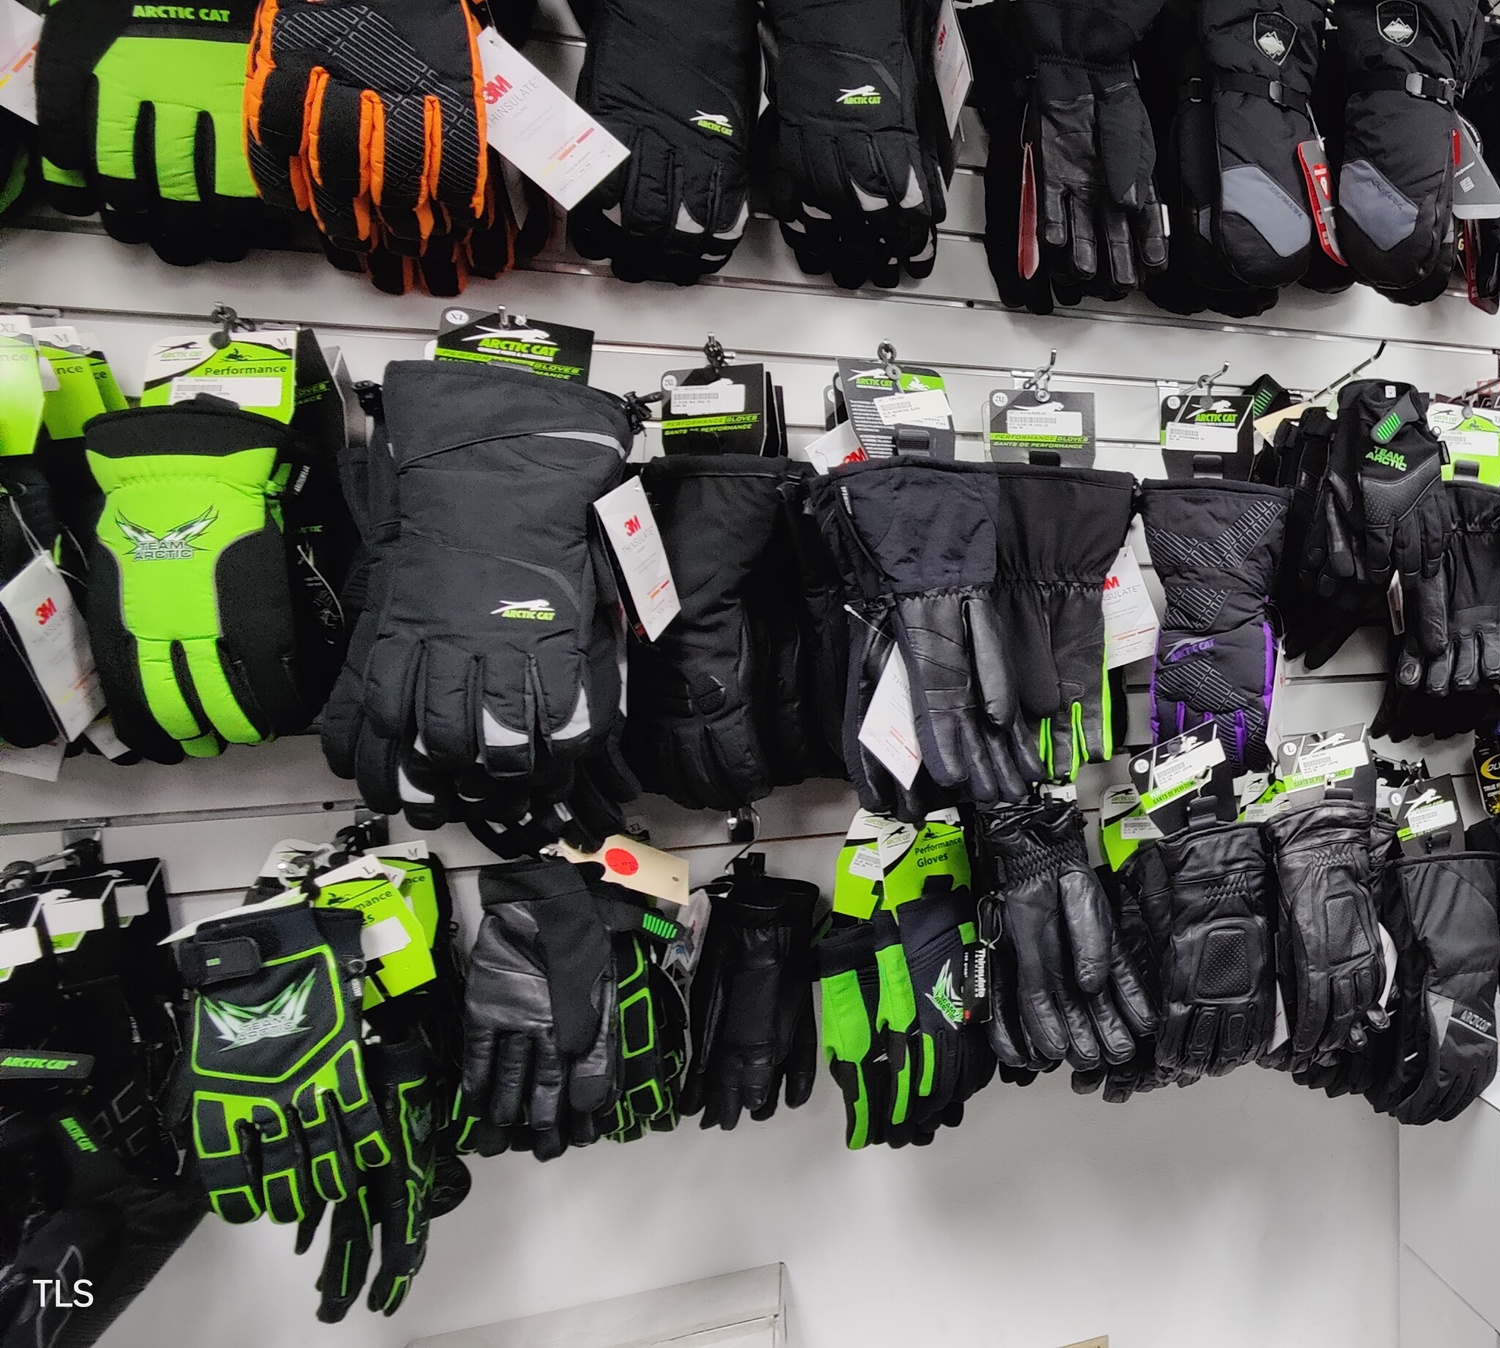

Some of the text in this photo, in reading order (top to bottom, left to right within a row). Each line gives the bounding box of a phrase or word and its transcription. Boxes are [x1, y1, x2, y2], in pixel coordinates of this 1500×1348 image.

[133, 5, 230, 23] ARCTIC CAT
[484, 74, 513, 105] 3M
[844, 94, 881, 105] ARCTIC CAT
[697, 119, 733, 136] ARCTIC CAT
[477, 338, 526, 353] ARCTIC
[528, 344, 560, 357] CAT
[204, 365, 287, 376] Performance
[856, 378, 893, 387] ARCTIC CAT
[1195, 413, 1236, 423] ARCTIC CAT
[1365, 453, 1407, 472] ARCTIC
[1373, 446, 1404, 463] TEAM
[623, 515, 641, 537] 3M
[138, 540, 186, 552] TEAM
[133, 548, 195, 562] ARCTIC
[1104, 576, 1120, 590] M
[35, 597, 58, 625] 3M
[502, 608, 555, 621] ARCTIC CAT
[1171, 638, 1215, 662] ARCTIC CAT
[915, 837, 962, 855] Performance
[917, 852, 948, 868] Gloves
